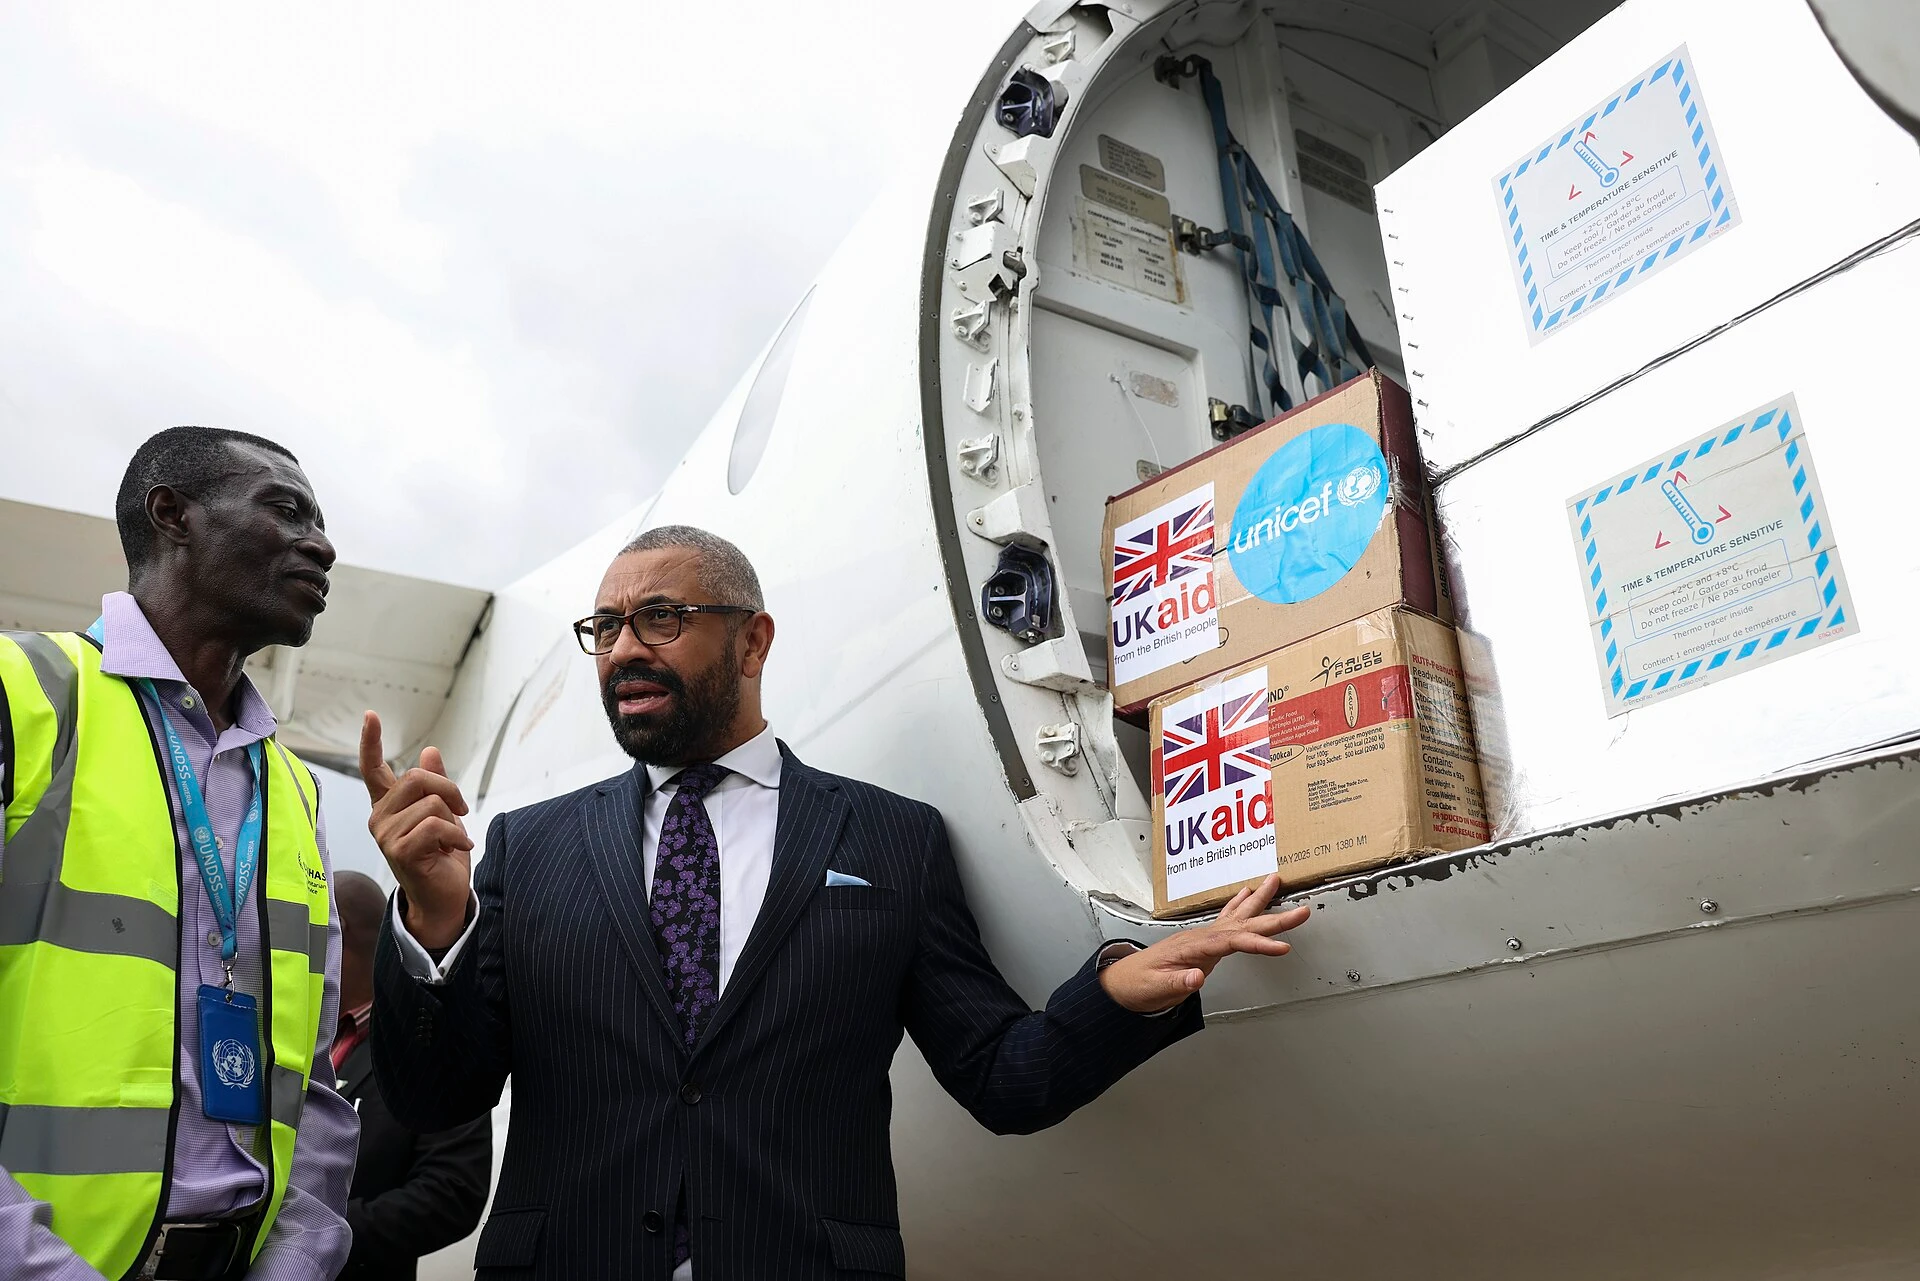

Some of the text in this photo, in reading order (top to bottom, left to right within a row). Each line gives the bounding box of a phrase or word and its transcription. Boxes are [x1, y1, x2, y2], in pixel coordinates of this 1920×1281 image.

[1539, 150, 1679, 243] TIME & TEMPERATURE SENSITIVE
[1557, 260, 1568, 270] Do
[1569, 252, 1582, 264] not
[1583, 236, 1607, 253] freeze
[1614, 224, 1625, 234] Ne
[1627, 215, 1641, 228] pas
[1643, 191, 1677, 217] congeler
[1563, 244, 1582, 256] Keep
[1584, 231, 1599, 244] cool
[1606, 209, 1633, 230] Garder
[1635, 202, 1645, 212] au
[1646, 188, 1666, 205] froid
[1604, 210, 1619, 222] and
[1584, 226, 1654, 271] Thermo tracer inside
[1560, 283, 1586, 303] Contient
[1594, 255, 1634, 282] enregistreur
[1636, 245, 1645, 256] de
[1233, 481, 1333, 554] unicef
[1620, 519, 1784, 594] TIME & TEMPERATURE SENSITIVE
[1648, 602, 1670, 616] Keep
[1671, 594, 1690, 607] cool
[1698, 577, 1733, 596] Garder
[1733, 573, 1744, 582] au
[1746, 563, 1768, 579] froid
[1695, 574, 1713, 587] and
[1640, 618, 1654, 630] Do
[1655, 612, 1670, 625] not
[1671, 602, 1699, 619] freeze
[1707, 593, 1721, 605] Ne
[1723, 586, 1739, 600] pas
[1741, 569, 1782, 593] congeler
[1672, 604, 1754, 640] Thermo tracer inside
[1114, 617, 1217, 665] from the British people
[1642, 610, 1797, 671] Contient 1 enregistreur de température
[1334, 650, 1382, 670] ARIEL
[1335, 657, 1383, 678] FOODS
[1412, 667, 1456, 689] Ready-to-Use
[1305, 753, 1316, 761] Pour
[1354, 738, 1364, 747] kcal
[1306, 742, 1323, 753] Valeur
[1356, 727, 1383, 739] moyenne
[169, 735, 192, 806] UNDSS NIGERIA
[1306, 761, 1317, 769] Pour
[1354, 747, 1364, 756] kcal
[1422, 753, 1454, 769] Contains:
[1424, 764, 1434, 773] 150
[1435, 766, 1453, 777] Sachets
[1424, 777, 1434, 786] Net
[1435, 779, 1451, 790] Weight
[1425, 788, 1440, 798] Gross
[1439, 790, 1457, 802] Weight
[1427, 800, 1452, 811] Case Cube
[1432, 811, 1464, 823] PRODUCED
[1433, 824, 1446, 833] NOT
[1446, 825, 1458, 835] FOR
[1166, 835, 1275, 876] from the British people
[1313, 843, 1331, 857] CTN
[1335, 838, 1354, 852] 1380
[199, 844, 225, 920] UNDSS NIGERIA
[237, 840, 255, 907] UNDSS NIGERIA
